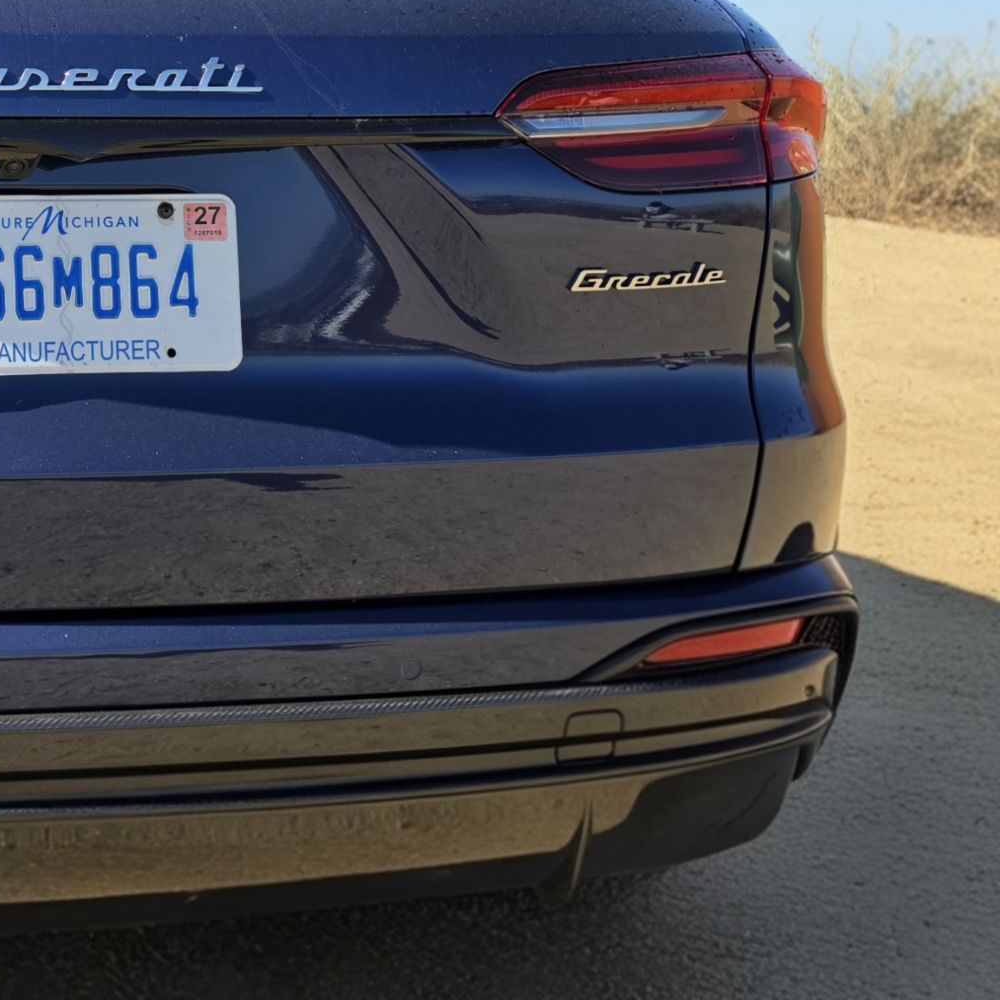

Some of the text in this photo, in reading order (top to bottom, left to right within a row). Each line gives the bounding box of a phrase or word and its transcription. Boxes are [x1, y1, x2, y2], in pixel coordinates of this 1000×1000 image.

[21, 205, 140, 241] MICHIGAN
[194, 206, 221, 225] 27
[571, 263, 727, 292] Grecale
